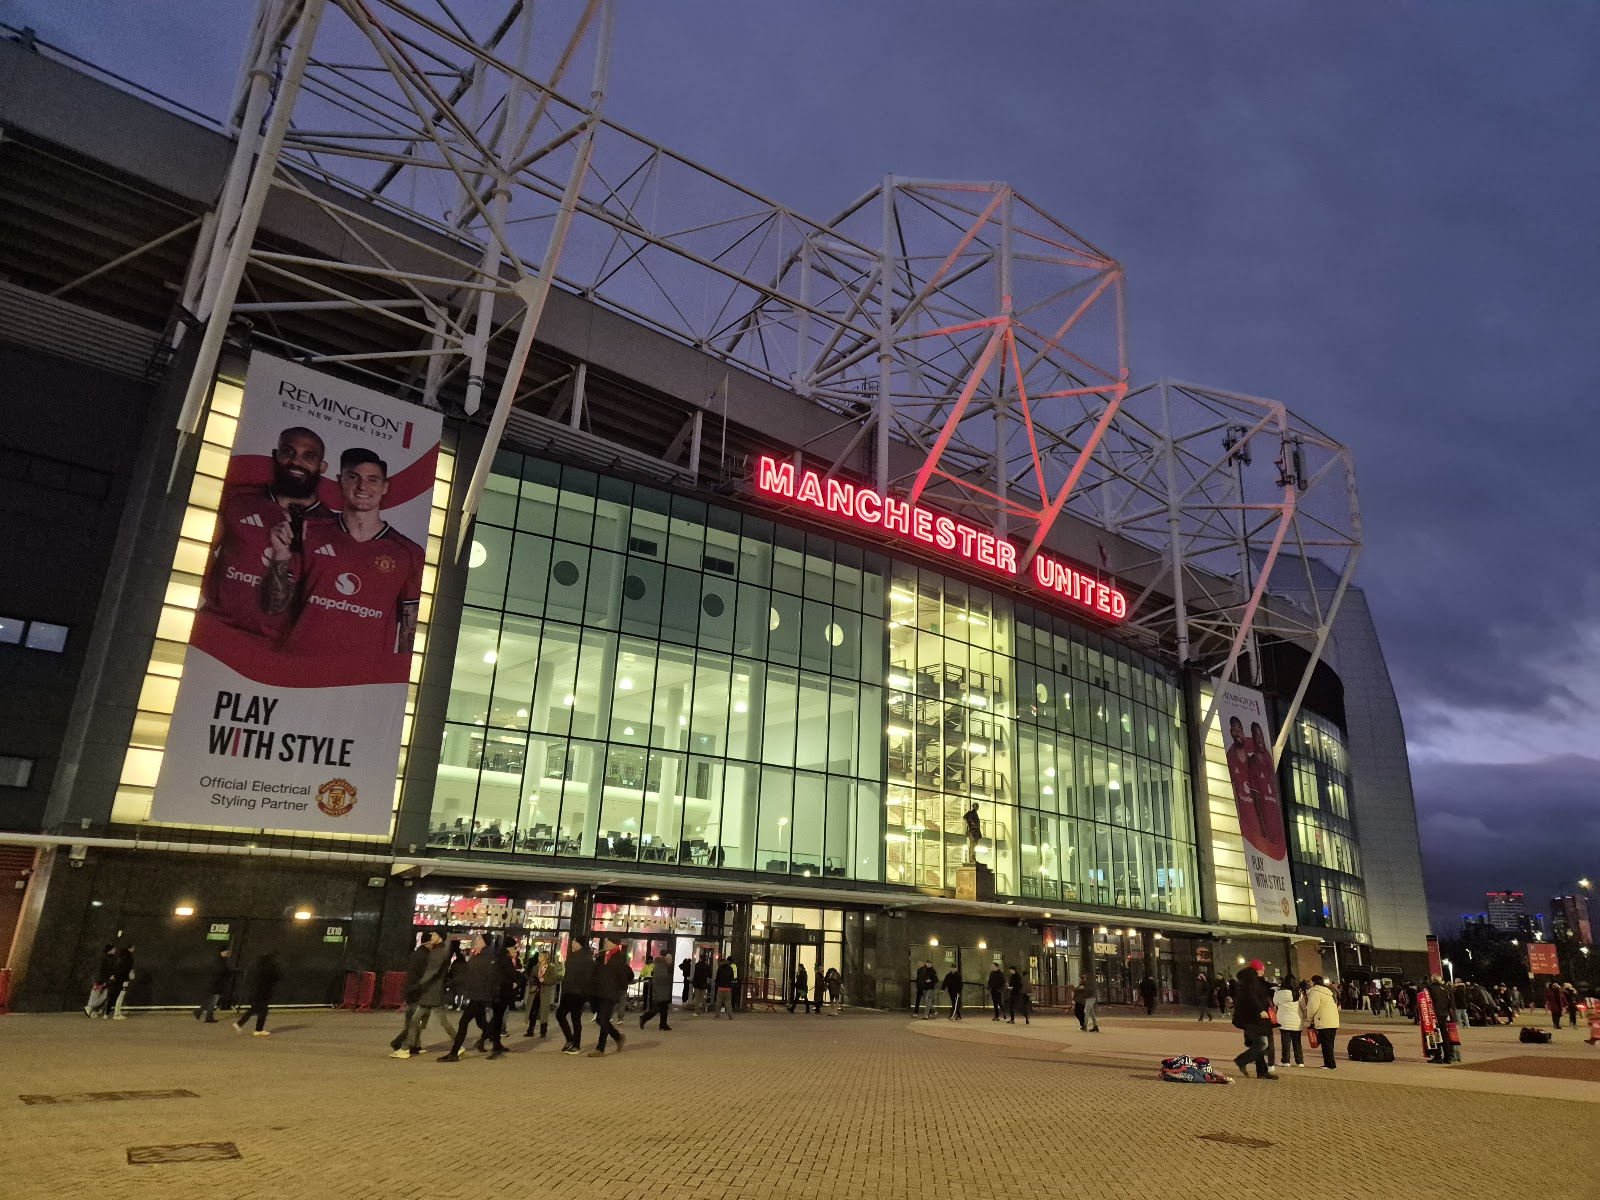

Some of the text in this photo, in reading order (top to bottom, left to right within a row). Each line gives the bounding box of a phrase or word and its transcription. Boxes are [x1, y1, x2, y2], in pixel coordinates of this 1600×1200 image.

[278, 380, 400, 433] REMINGTON
[308, 410, 333, 421] NEW
[338, 419, 366, 432] YORK
[370, 429, 393, 440] 1937
[759, 456, 1126, 619] MANCHESTER UNITED
[308, 594, 383, 619] napdragon
[213, 690, 278, 725] PLAY
[208, 725, 355, 767] WITH STYLE
[200, 776, 311, 795] Official Electrical
[210, 794, 309, 811] Styling Partner
[1268, 875, 1285, 891] STYLE
